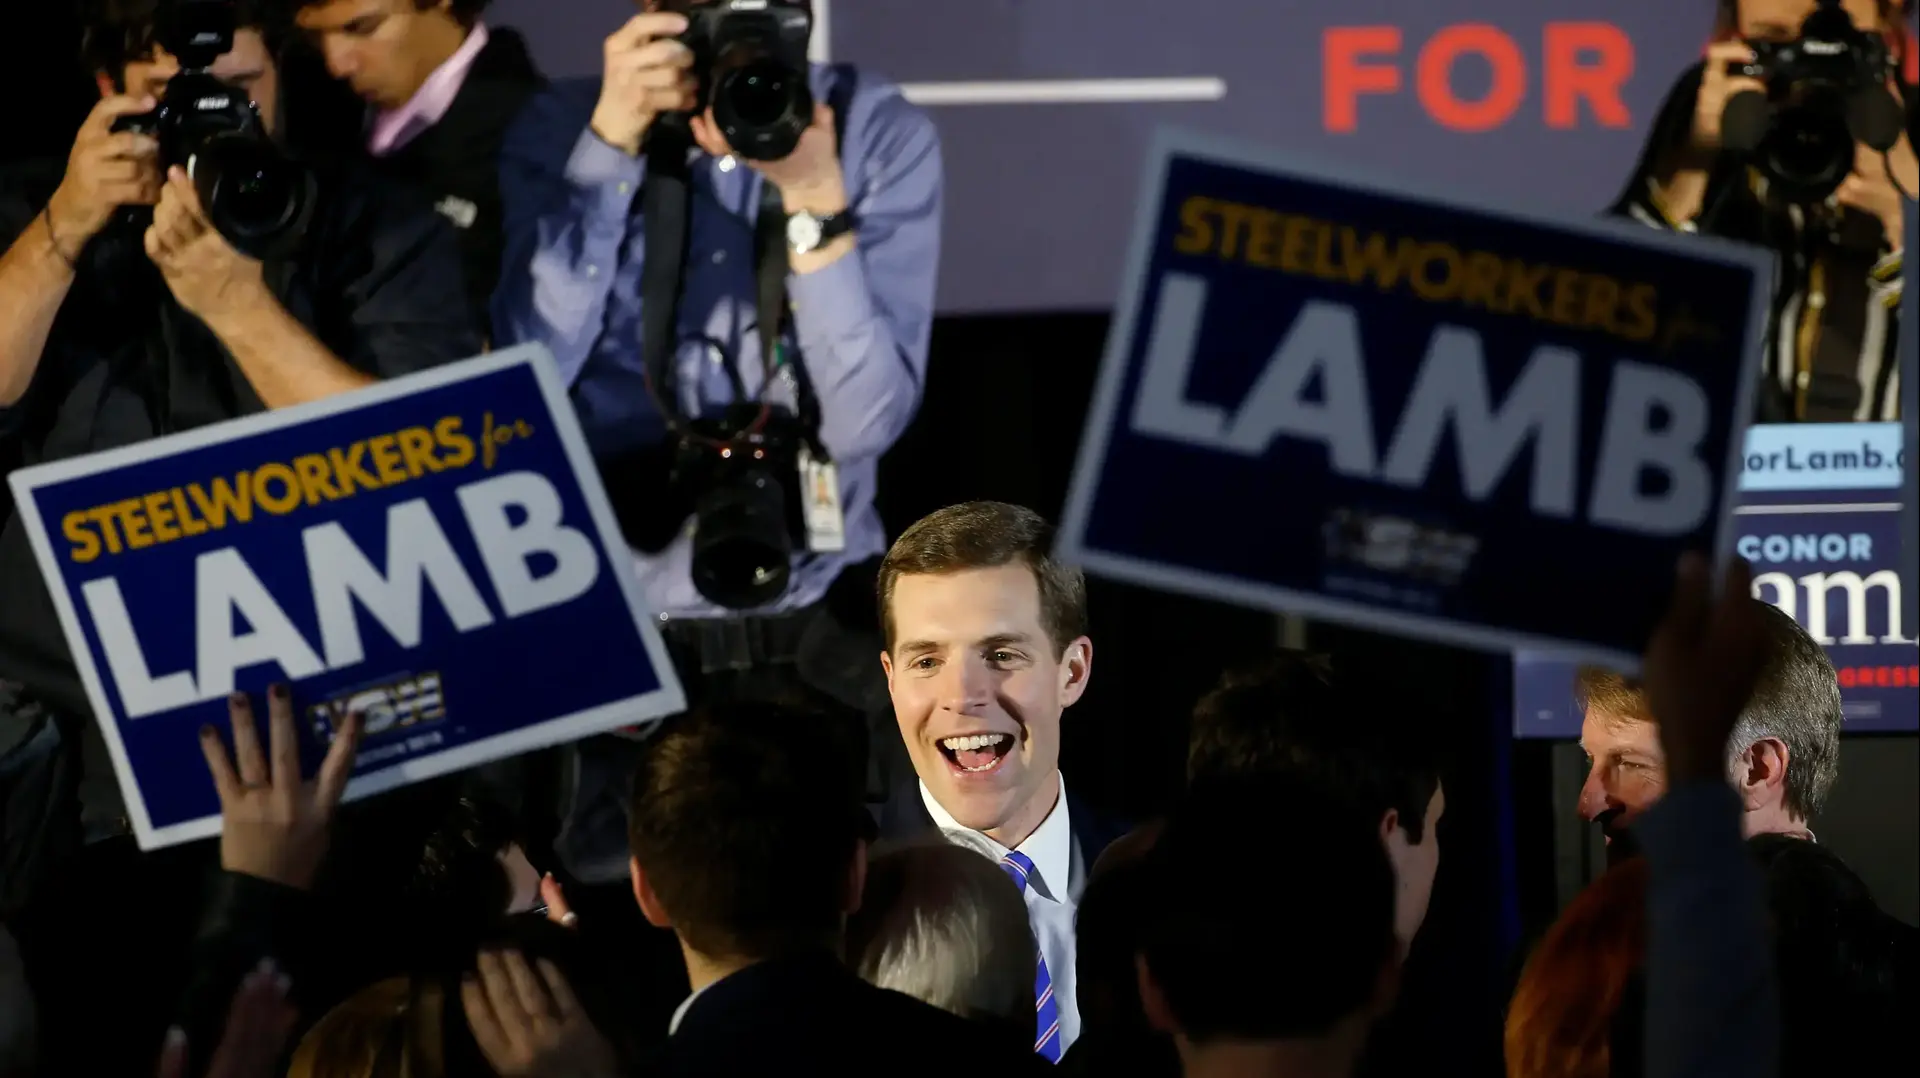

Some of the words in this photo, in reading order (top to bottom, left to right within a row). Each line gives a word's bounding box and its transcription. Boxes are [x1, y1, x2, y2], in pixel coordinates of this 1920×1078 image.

[1322, 21, 1634, 132] FOR
[1174, 197, 1657, 341] STEELWORKERS
[1130, 272, 1712, 536] LAMB
[62, 416, 475, 563] STEELWORKERS
[481, 411, 534, 469] for
[1737, 533, 1872, 563] CONOR
[81, 471, 599, 718] LAMB
[1751, 569, 1919, 646] am
